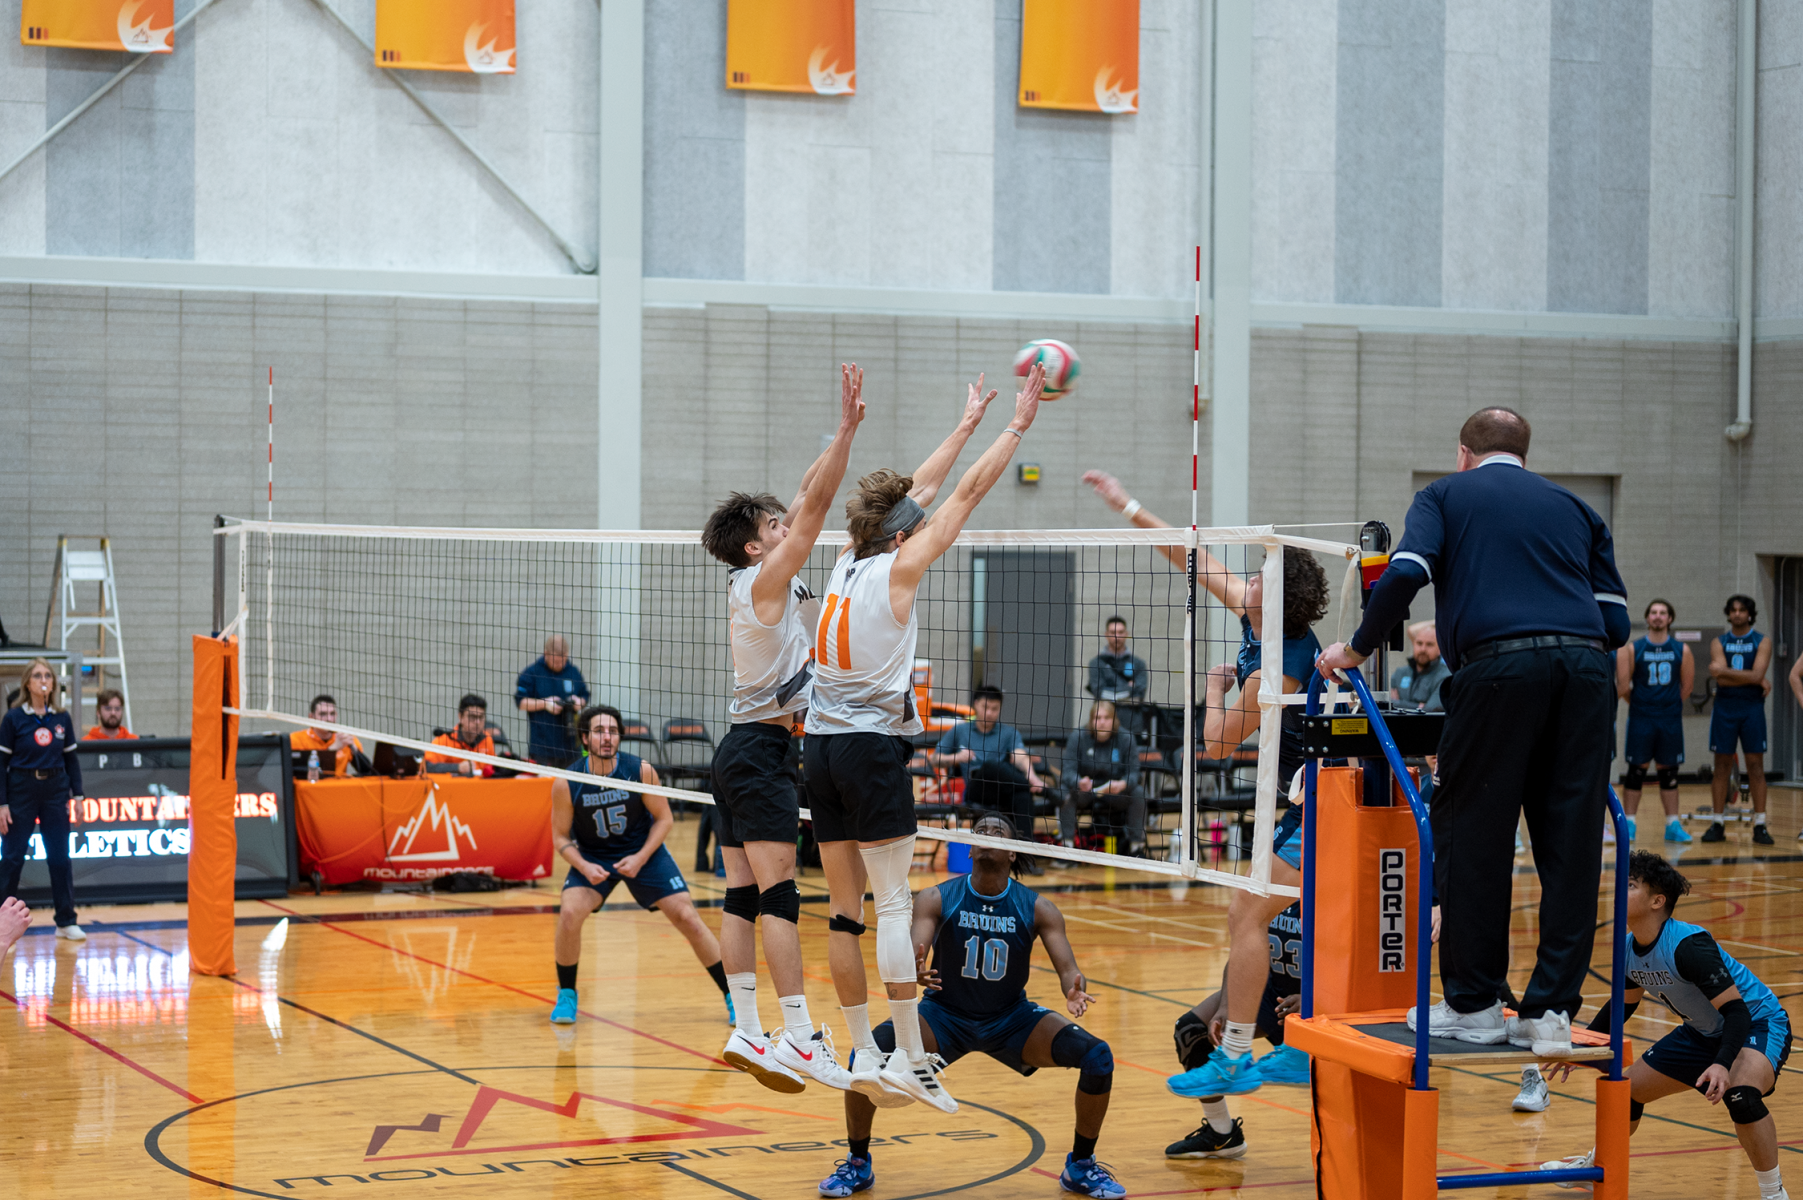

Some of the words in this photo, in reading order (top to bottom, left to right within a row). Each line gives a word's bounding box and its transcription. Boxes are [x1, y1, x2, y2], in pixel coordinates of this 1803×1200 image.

[582, 788, 630, 807] BRUINS
[592, 804, 628, 838] 15
[24, 827, 191, 861] TLETICS
[958, 910, 1016, 933] BRUINS
[1268, 914, 1302, 934] RUIN
[961, 935, 1009, 981] 10
[1630, 969, 1674, 986] BRUINS
[272, 1129, 999, 1189] mountaineers
